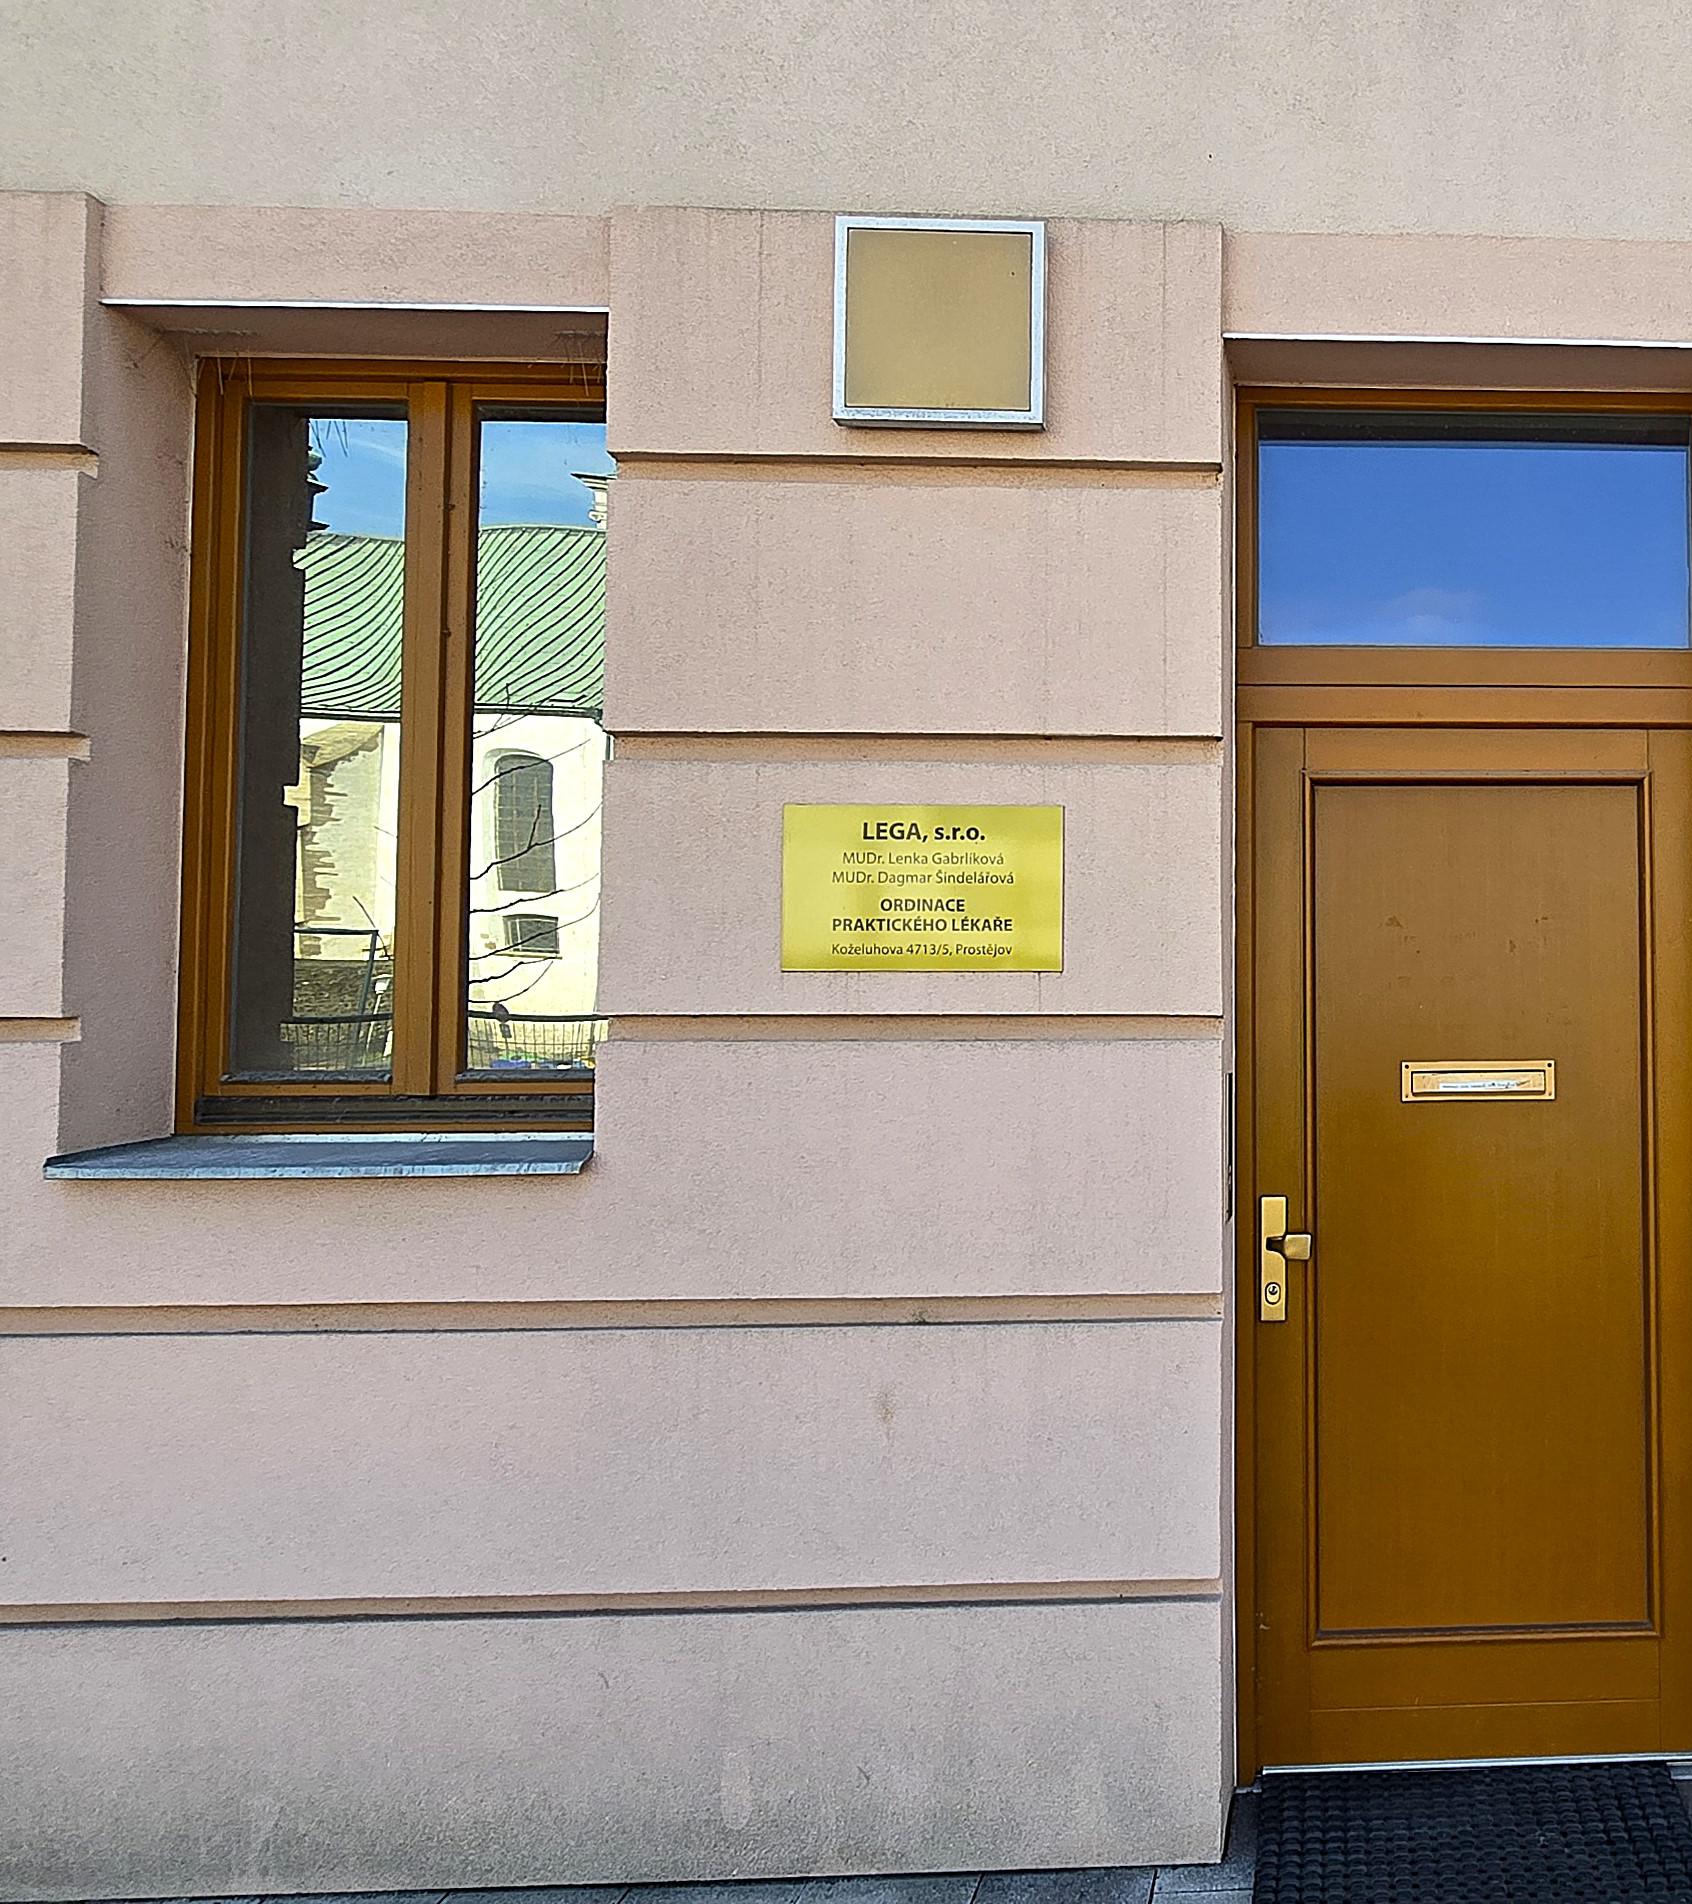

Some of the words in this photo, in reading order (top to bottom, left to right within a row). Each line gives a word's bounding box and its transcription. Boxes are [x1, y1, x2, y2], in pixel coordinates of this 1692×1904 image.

[862, 822, 928, 843] LEGA,
[934, 825, 986, 841] s.r.o.
[842, 852, 885, 865] MUDr.
[888, 852, 928, 865] Lenka
[932, 852, 1004, 865] Gabrlíková
[832, 871, 874, 884] MUDr.
[878, 871, 932, 887] Dagmar
[935, 869, 1014, 884] Šindelářová
[880, 898, 965, 912] ORDINACE
[832, 916, 947, 932] PRAKTICKÉHO
[951, 916, 1013, 932] LÉKAŘE
[832, 943, 903, 956] Koželuhova
[906, 944, 953, 957] 4713/5,
[955, 943, 1013, 958] Prostějov
